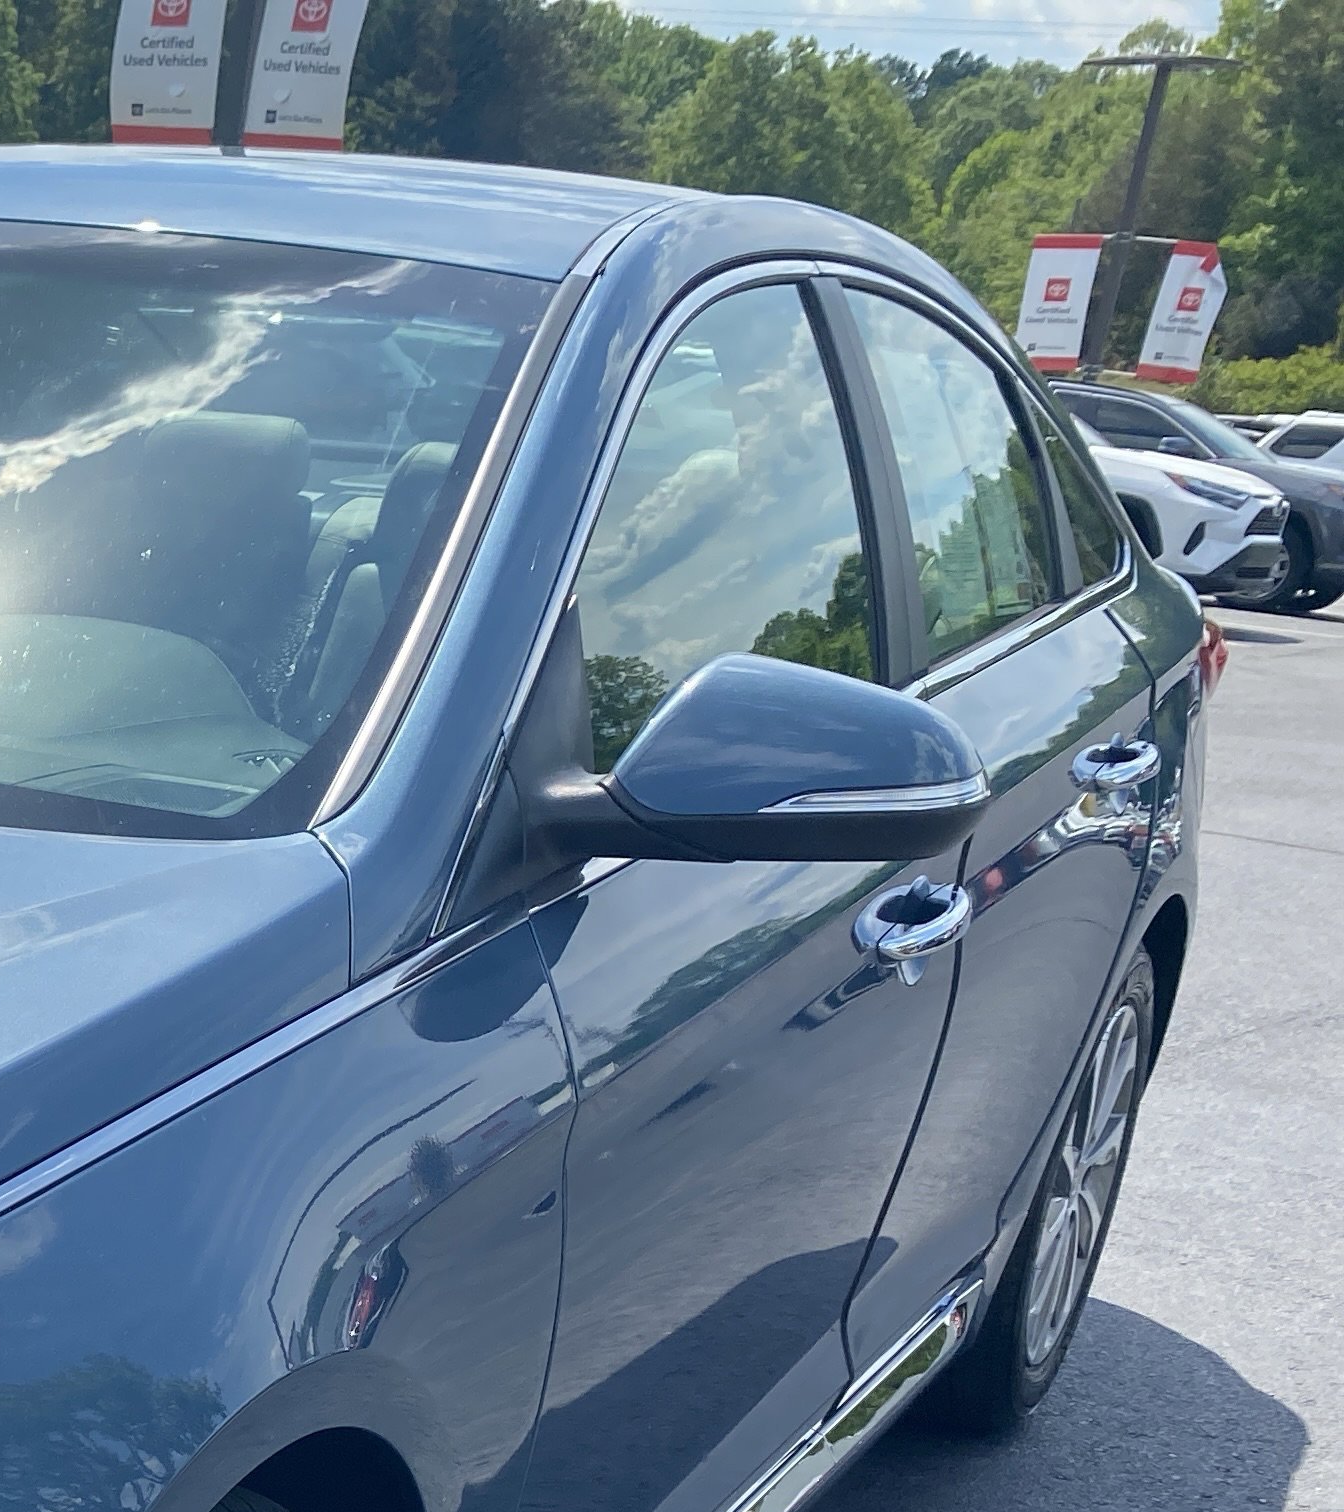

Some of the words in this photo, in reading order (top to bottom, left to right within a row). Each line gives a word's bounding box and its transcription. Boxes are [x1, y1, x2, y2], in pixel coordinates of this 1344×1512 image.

[140, 36, 194, 49] Certified
[280, 41, 331, 56] Certified
[123, 54, 154, 67] Used
[157, 54, 208, 67] Vehicles
[264, 60, 292, 73] Used
[294, 60, 340, 75] Vehicles
